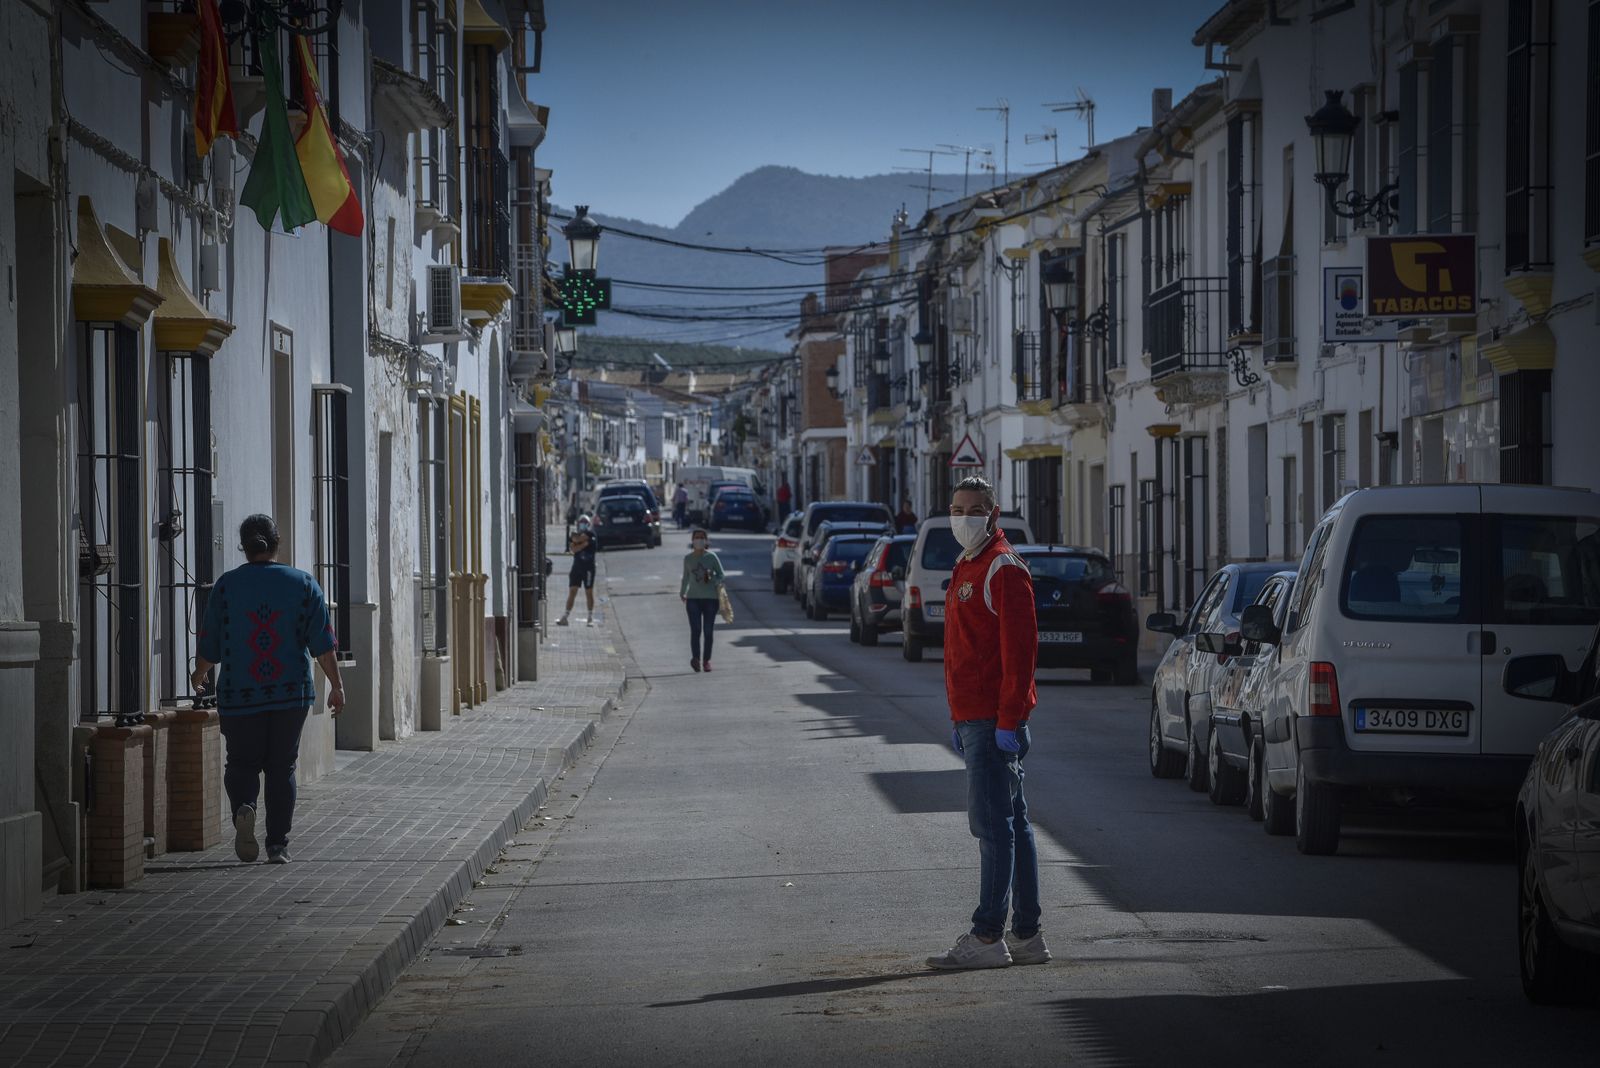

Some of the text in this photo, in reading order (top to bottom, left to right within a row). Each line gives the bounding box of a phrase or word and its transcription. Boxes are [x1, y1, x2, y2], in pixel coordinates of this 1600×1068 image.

[1373, 295, 1472, 313] TABACOS
[1369, 710, 1462, 728] 3409 DXG
